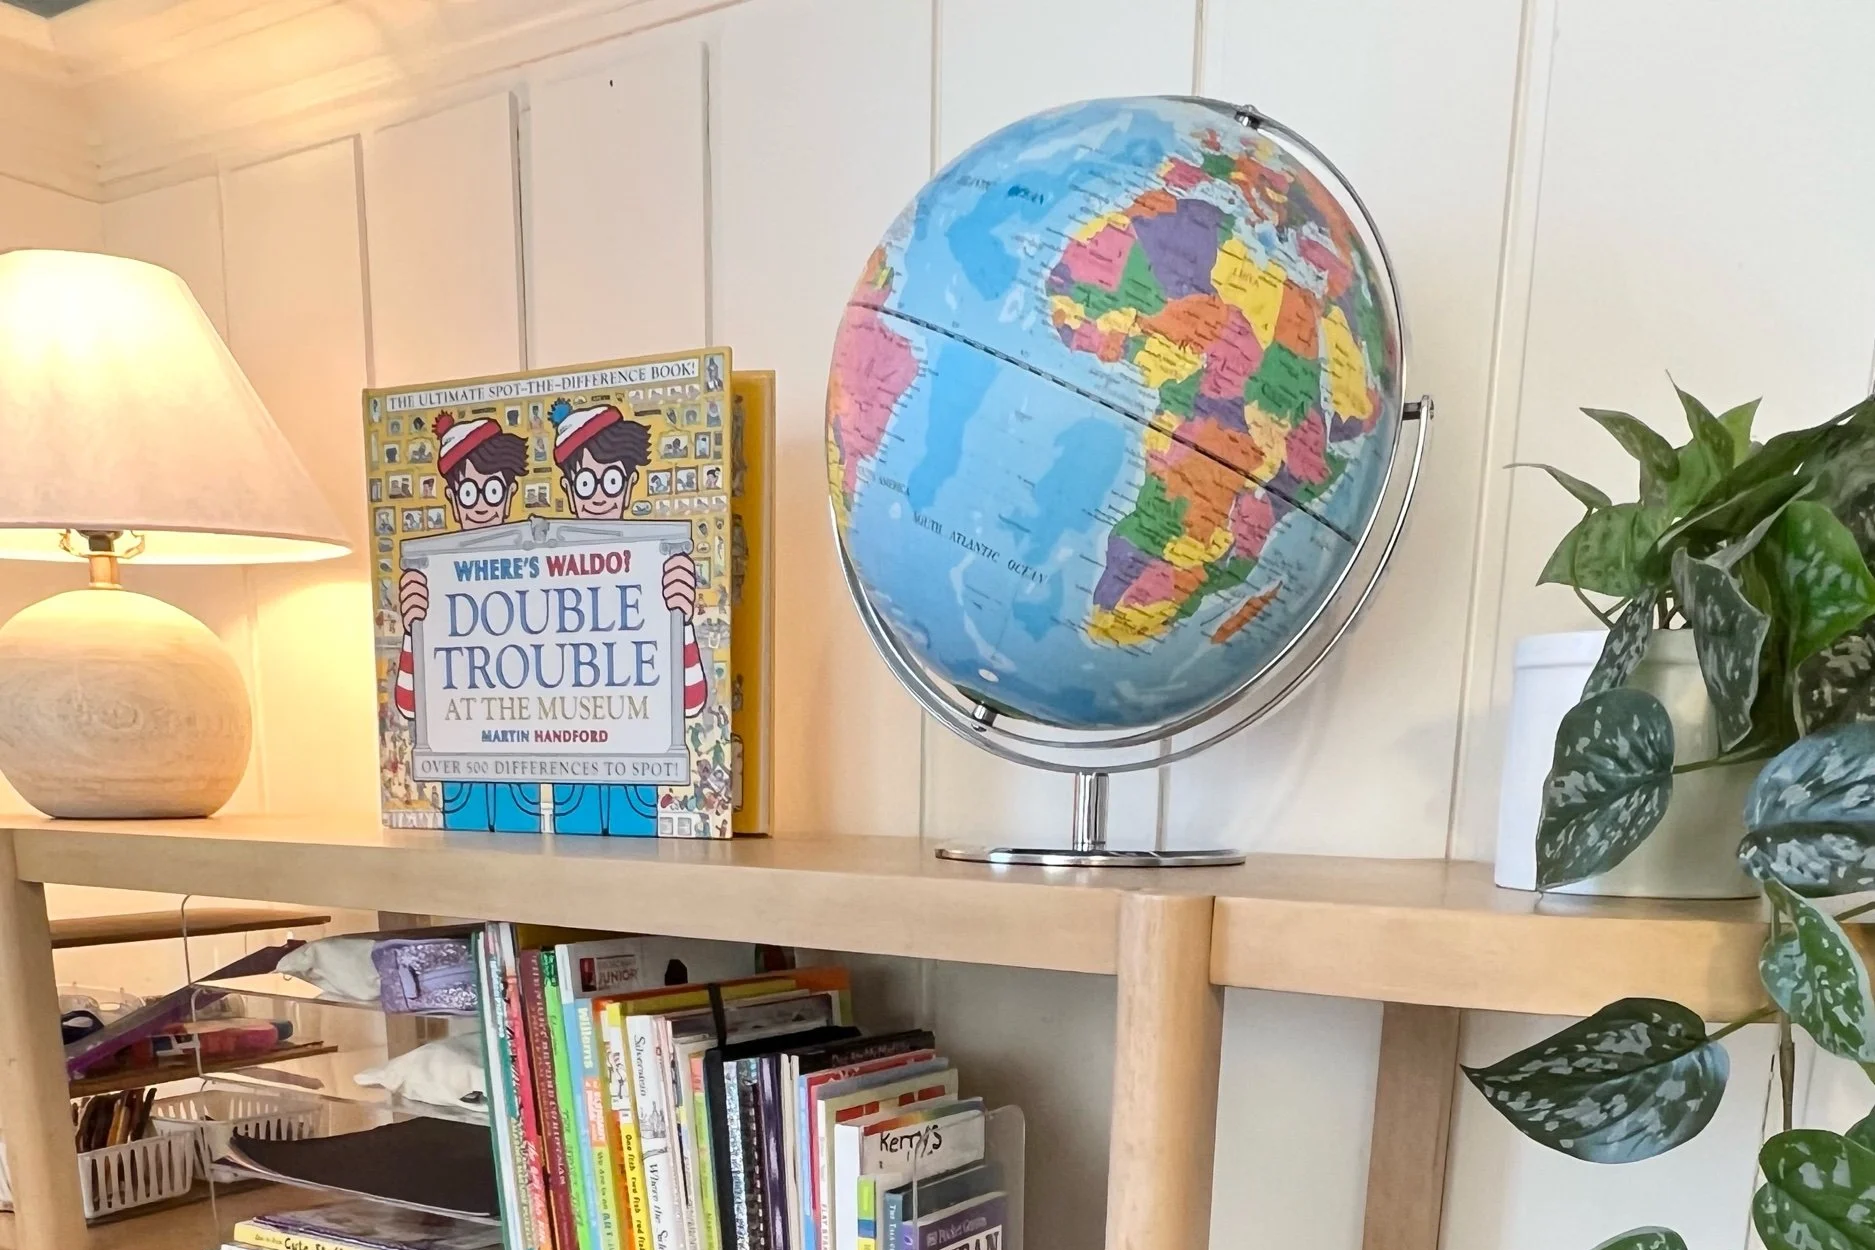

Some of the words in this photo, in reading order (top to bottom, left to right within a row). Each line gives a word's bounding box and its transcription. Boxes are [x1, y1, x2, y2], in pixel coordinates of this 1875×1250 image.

[390, 396, 415, 410] THE
[419, 388, 485, 407] ULTIMATE
[489, 368, 647, 398] SPOT-THE-DIFFERENCE
[651, 361, 695, 381] BOOK!
[453, 556, 540, 581] WHERE'S
[546, 550, 632, 577] WALDO?
[950, 531, 1001, 563] ATLANTIC
[1007, 559, 1049, 584] OCEAN
[445, 584, 645, 637] DOUBLE
[433, 640, 660, 690] TROUBLE
[445, 698, 478, 721] AT
[480, 697, 531, 721] THE
[537, 695, 650, 721] MUSEUM
[481, 730, 530, 743] MARTIN
[534, 729, 609, 743] HANDFORD
[421, 760, 461, 774] OVER
[466, 761, 489, 775] 500
[495, 761, 599, 776] DIFFERENCES
[604, 761, 626, 776] TO
[632, 761, 679, 777] SPOT!
[577, 1007, 595, 1069] Willems
[633, 1034, 648, 1097] Silverstein
[625, 1133, 634, 1151] One
[627, 1153, 636, 1171] fish
[630, 1176, 638, 1194] two
[649, 1163, 663, 1202] Where
[633, 1196, 642, 1214] fish
[654, 1204, 666, 1224] the
[635, 1219, 644, 1234] red
